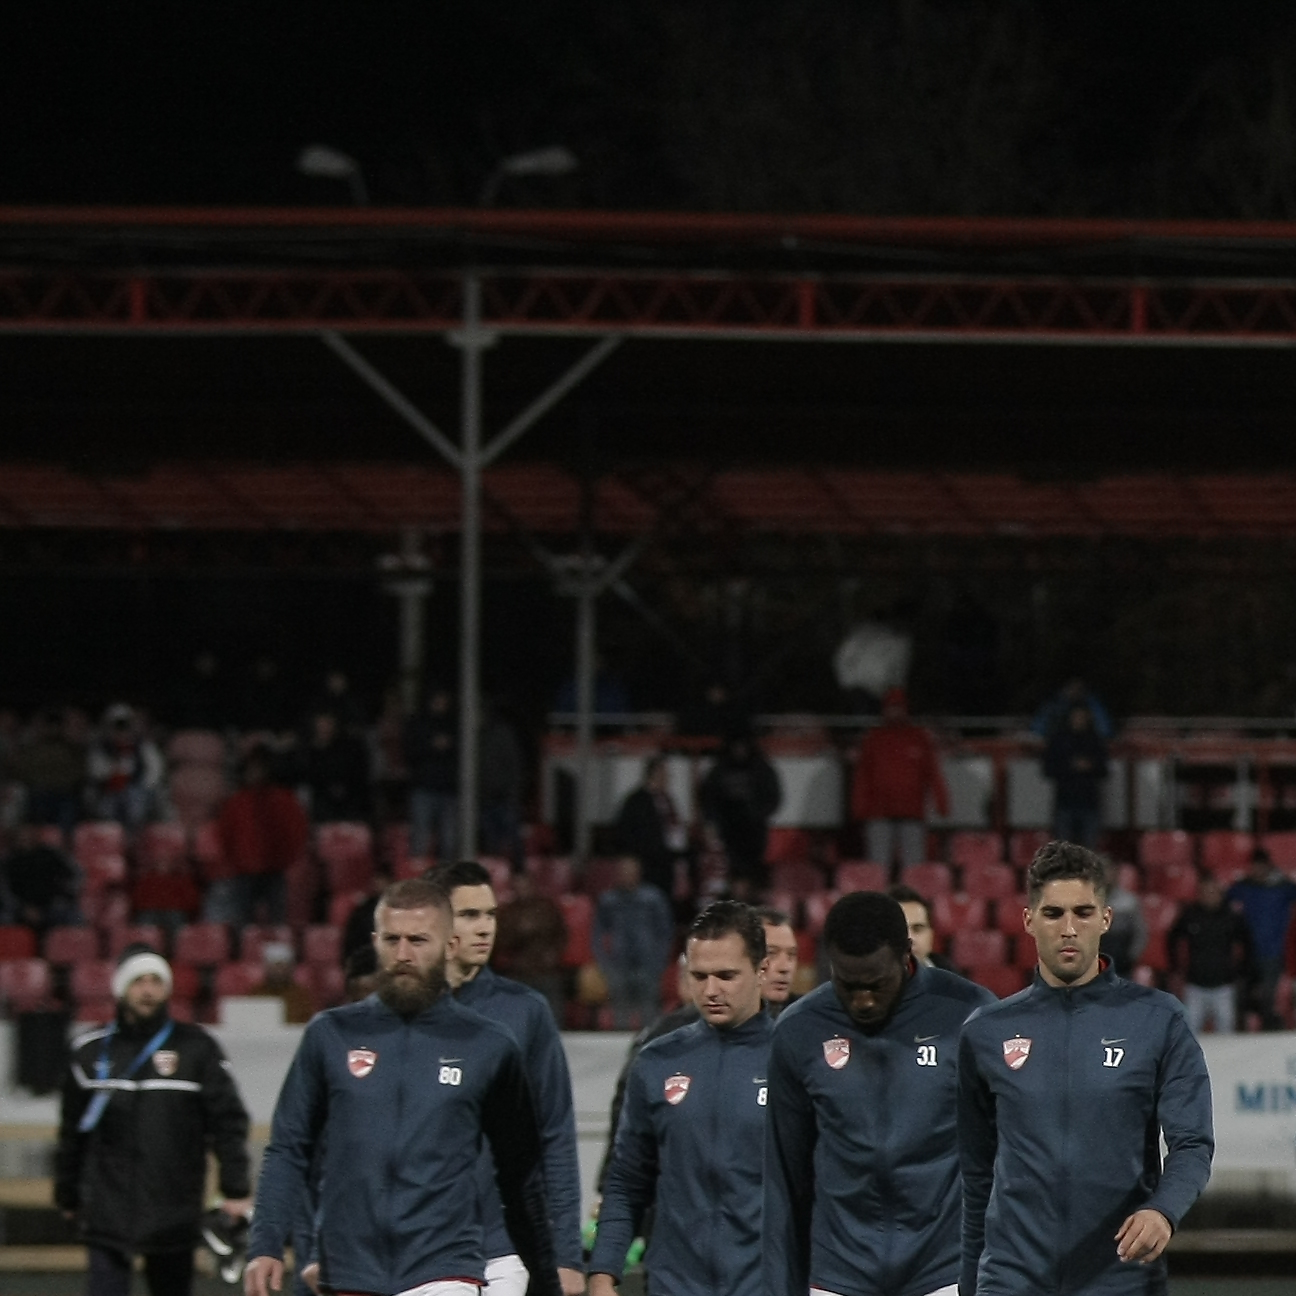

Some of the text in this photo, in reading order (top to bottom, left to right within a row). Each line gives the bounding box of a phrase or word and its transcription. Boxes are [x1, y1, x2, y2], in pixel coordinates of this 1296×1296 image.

[916, 1045, 938, 1066] 31
[1102, 1047, 1124, 1068] 17
[438, 1065, 463, 1086] 80
